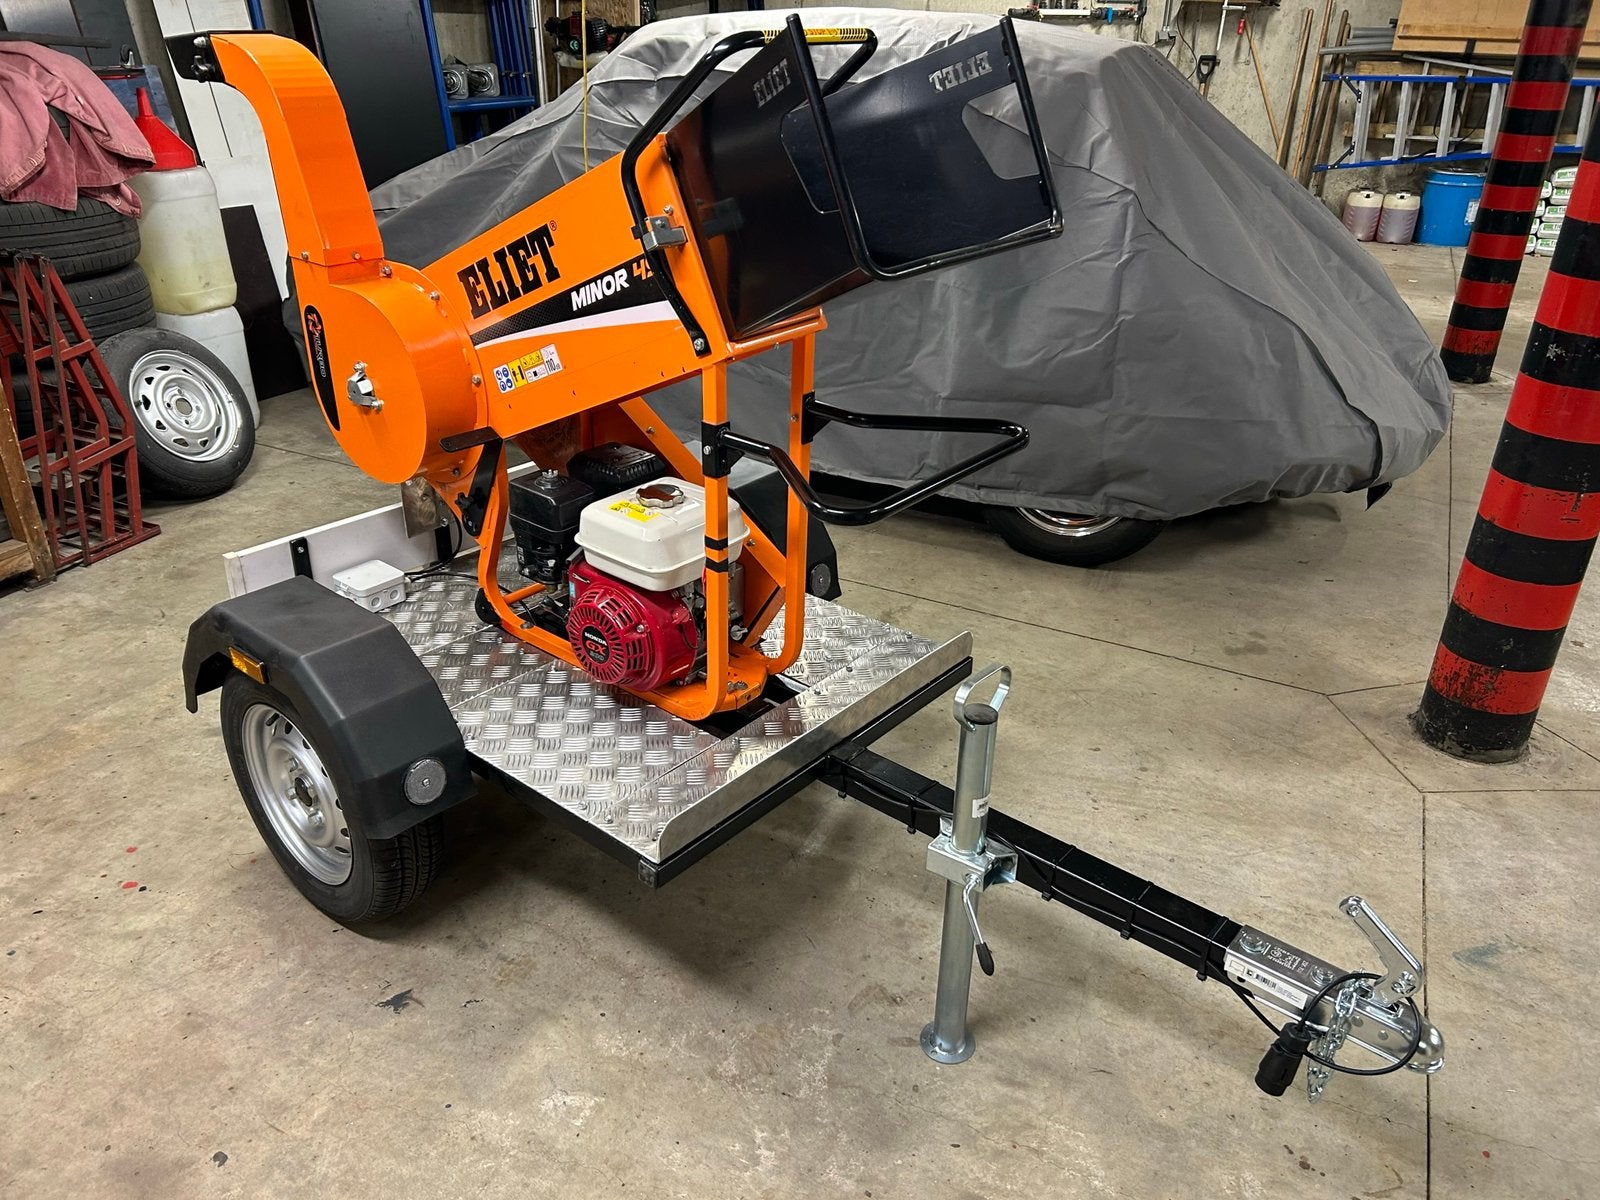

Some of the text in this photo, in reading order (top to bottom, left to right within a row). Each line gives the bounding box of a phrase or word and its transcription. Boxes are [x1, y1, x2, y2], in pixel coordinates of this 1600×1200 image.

[753, 58, 792, 108] ELIET
[457, 223, 561, 320] ELIET
[571, 268, 630, 311] MINOR
[584, 631, 608, 647] HONDA
[585, 640, 607, 656] GX
